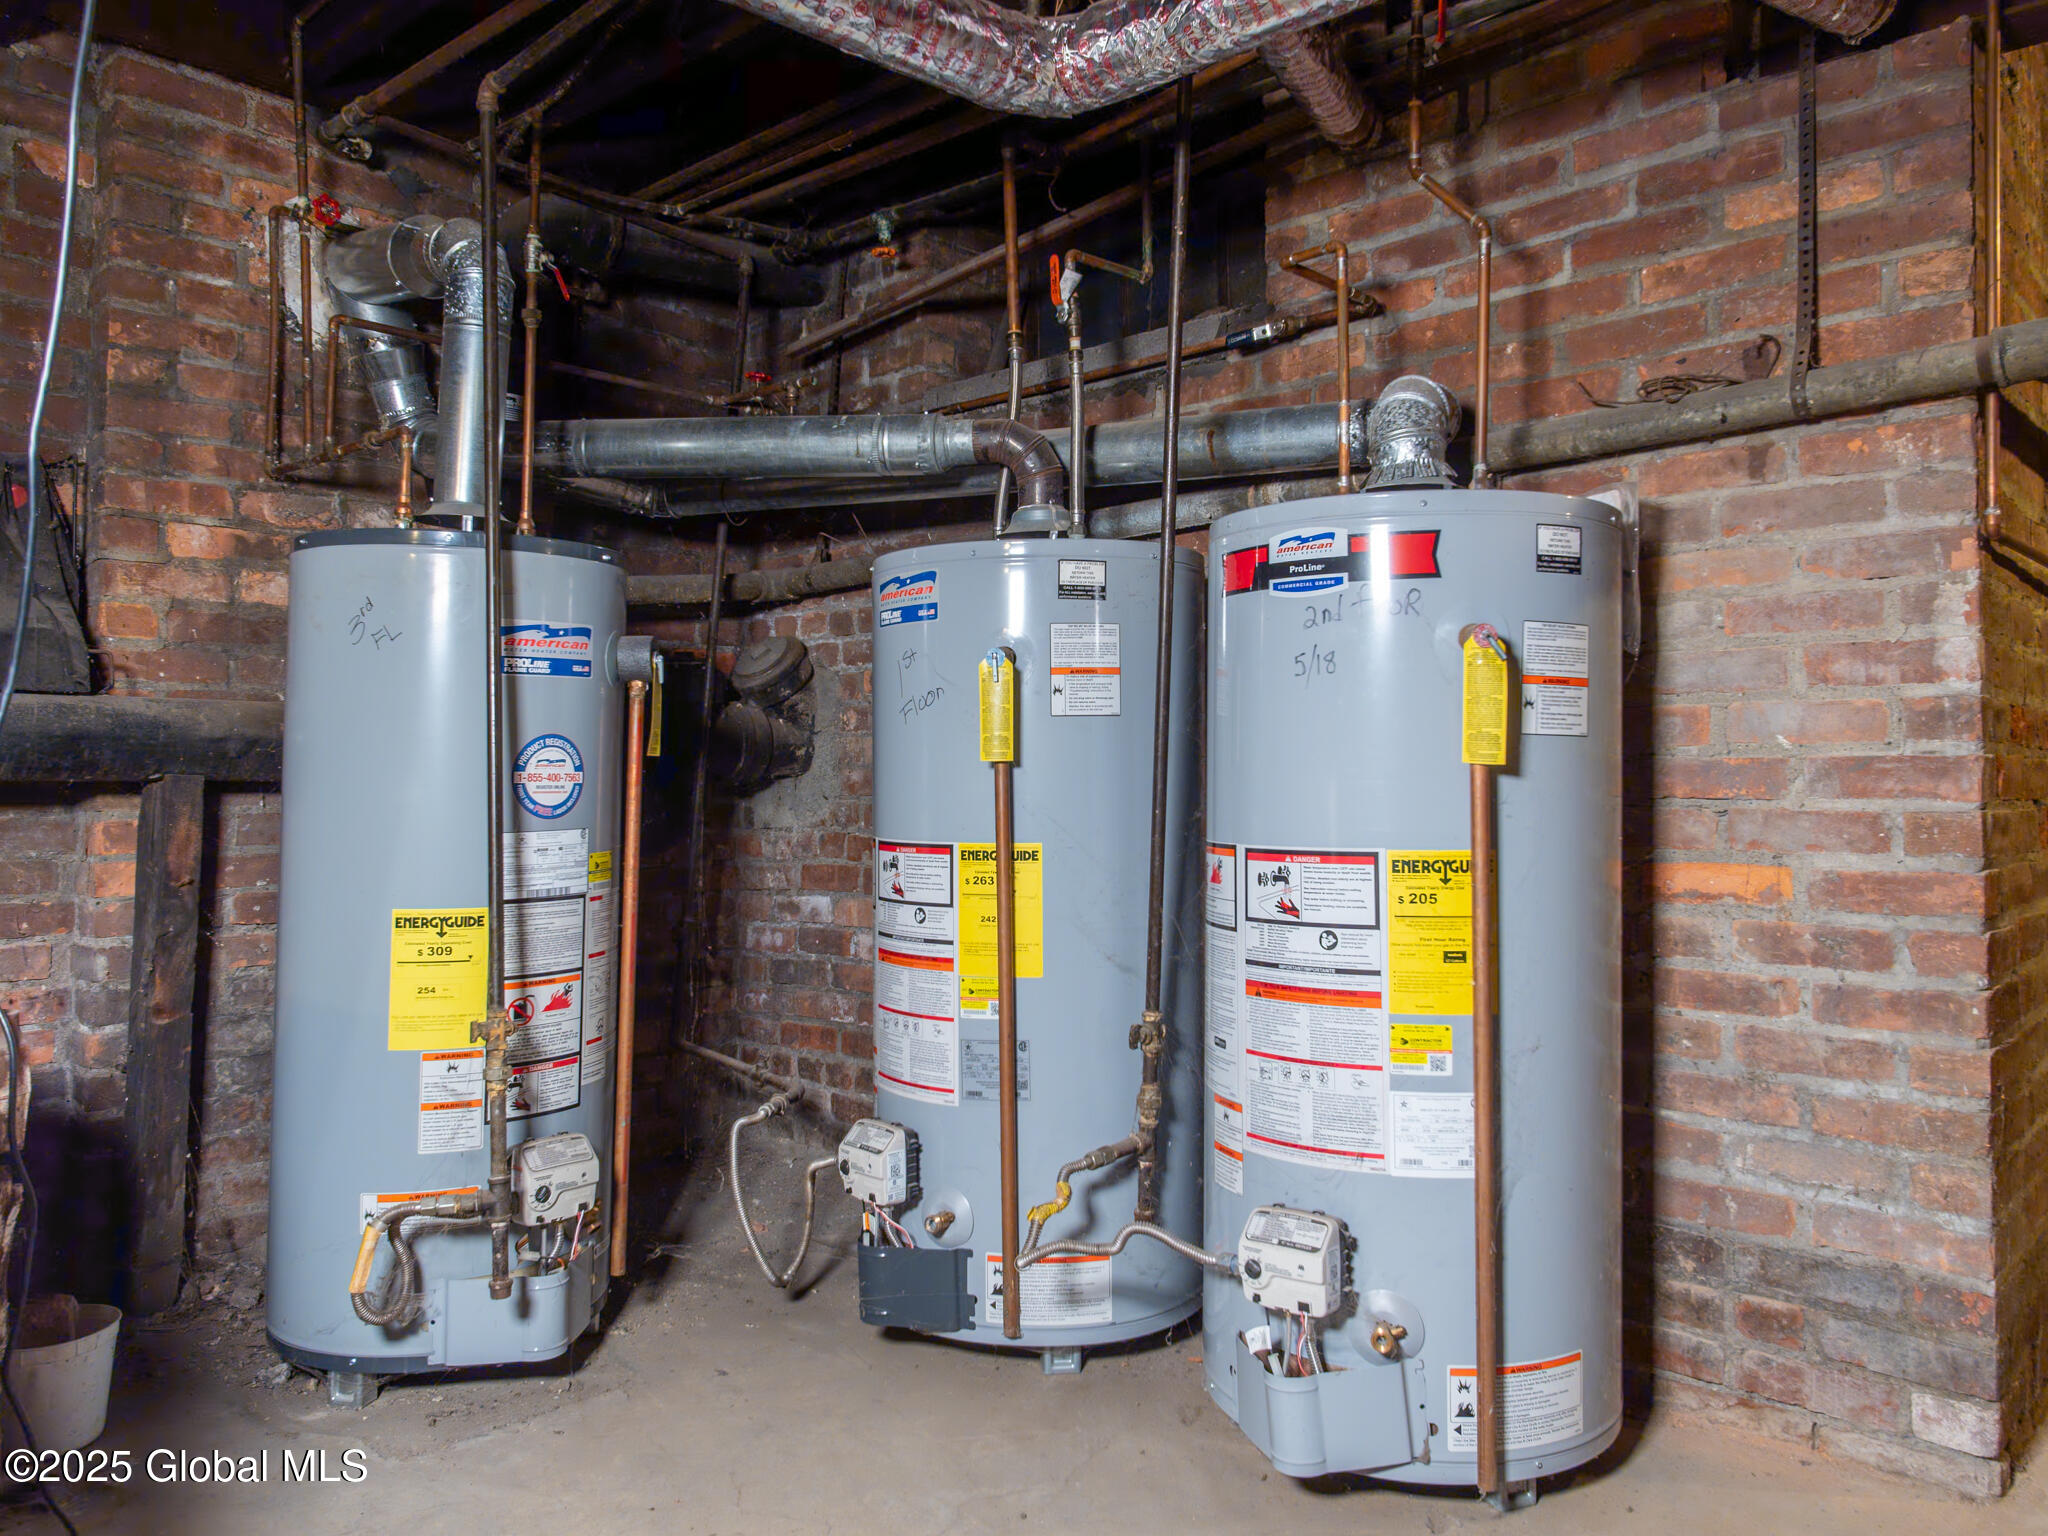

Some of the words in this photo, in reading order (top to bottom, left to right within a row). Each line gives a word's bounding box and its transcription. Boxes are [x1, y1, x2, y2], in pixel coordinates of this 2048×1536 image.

[1276, 542, 1334, 554] american
[1289, 564, 1323, 574] ProLine
[1277, 582, 1313, 590] COMMERCIAL
[880, 585, 934, 602] american
[503, 637, 589, 651] american
[1294, 643, 1336, 689] 5/18
[518, 739, 545, 766] PRODUCT
[545, 737, 581, 767] REGISTRATION
[973, 876, 994, 885] 263
[1408, 892, 1438, 904] 205
[395, 915, 485, 929] ENERGYGUIDE
[427, 946, 453, 956] 309
[529, 1062, 553, 1072] DANGER
